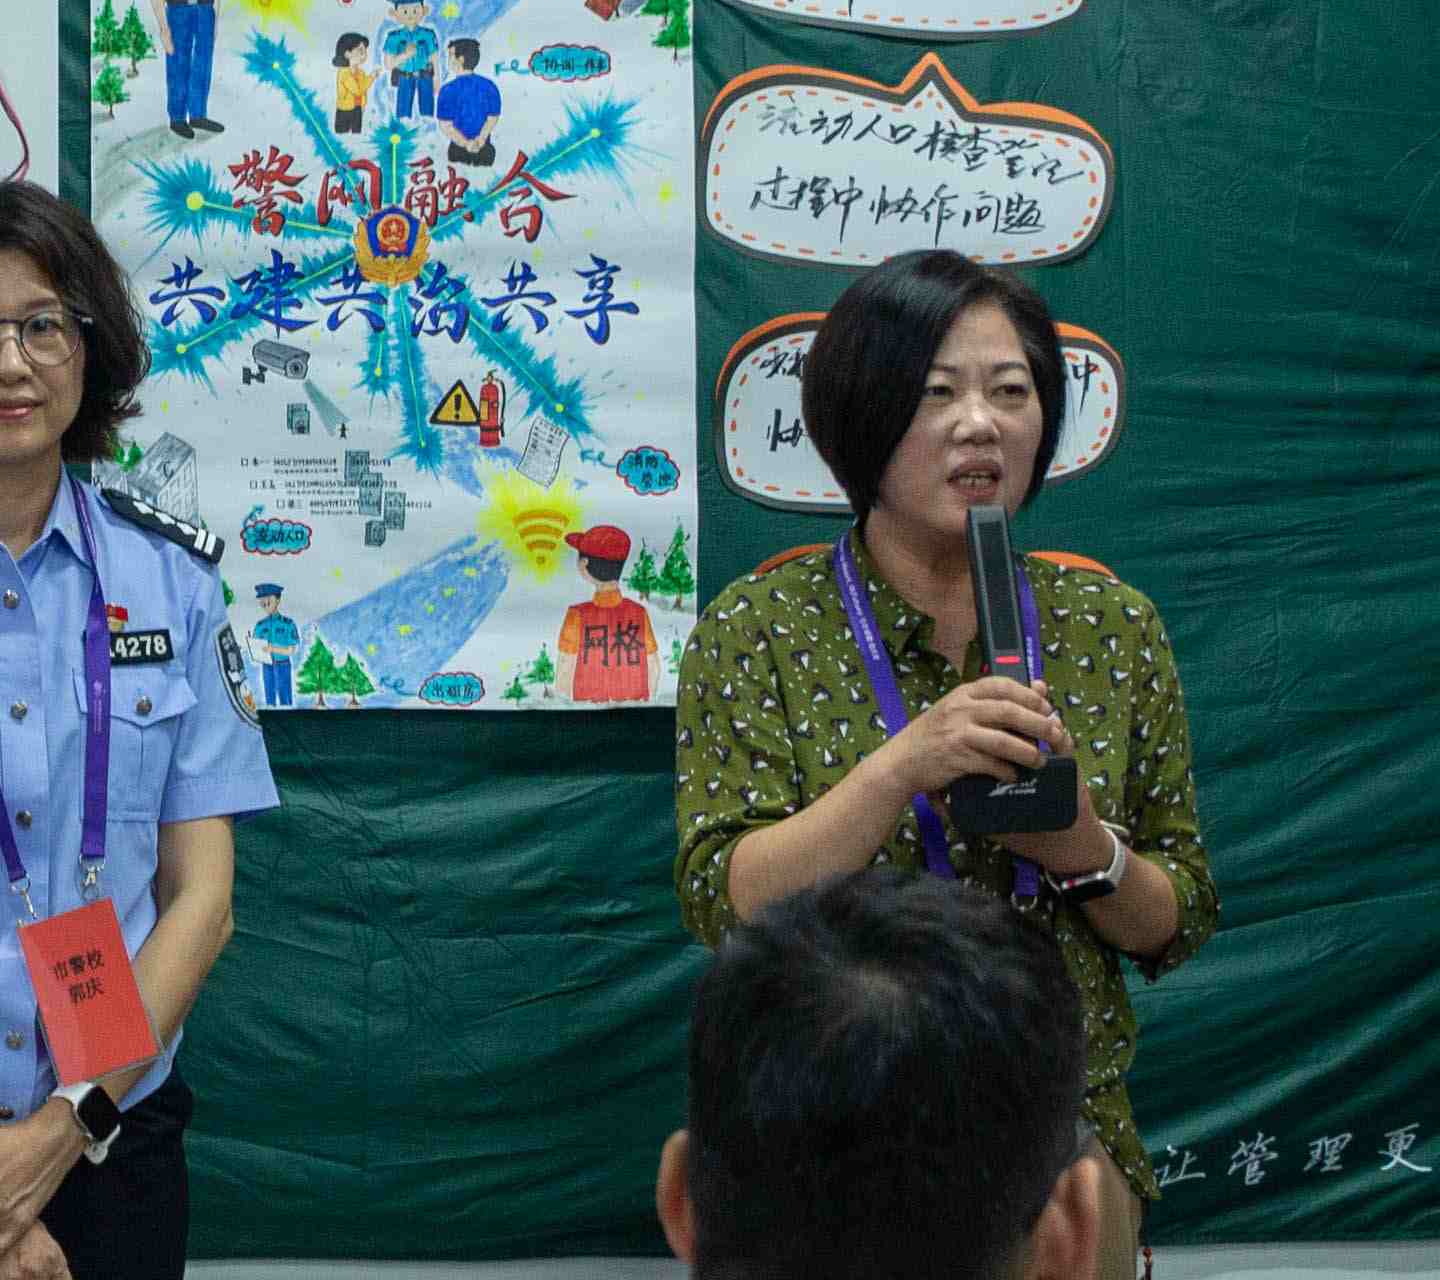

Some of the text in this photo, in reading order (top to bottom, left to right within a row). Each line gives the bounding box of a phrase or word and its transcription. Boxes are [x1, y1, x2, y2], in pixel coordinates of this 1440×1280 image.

[228, 144, 577, 243] 警网融合
[750, 165, 1046, 248] 过程中协作问题
[149, 248, 640, 345] 共建共治共享
[583, 620, 645, 667] 网格
[50, 949, 105, 981] 市警校
